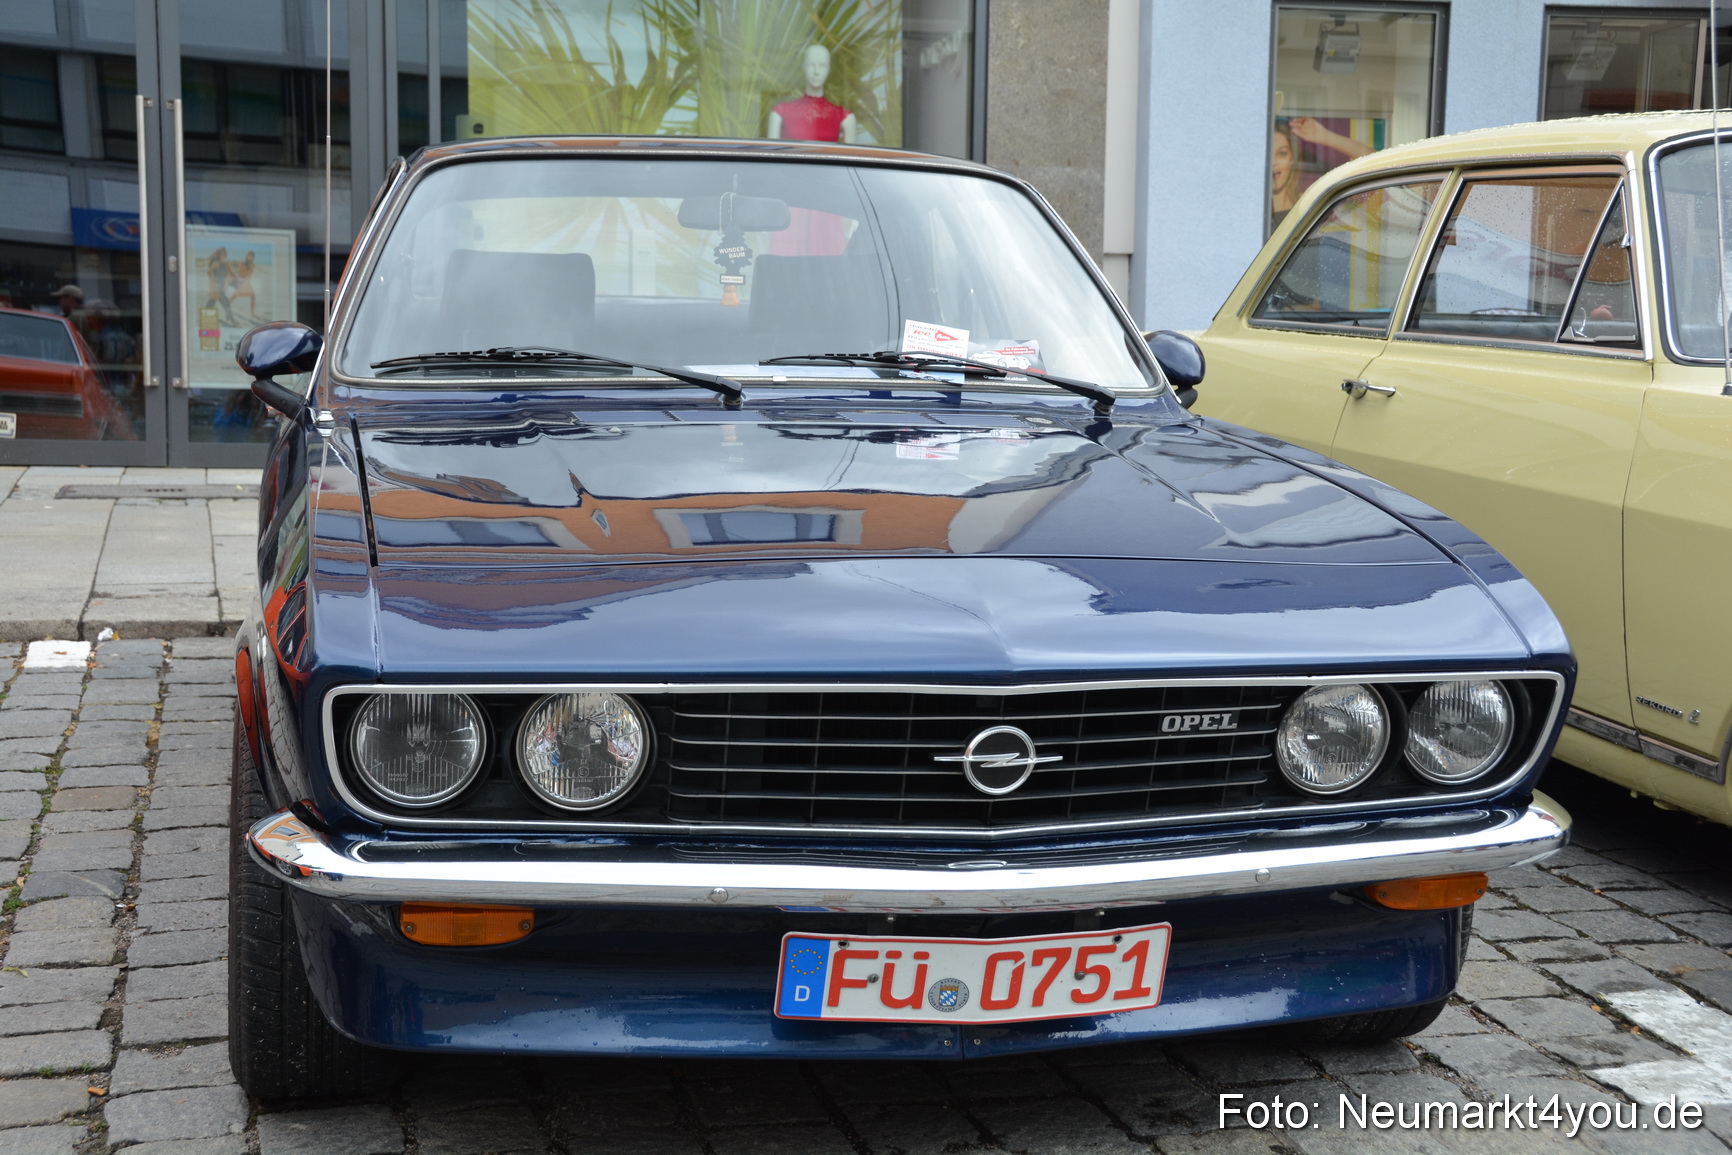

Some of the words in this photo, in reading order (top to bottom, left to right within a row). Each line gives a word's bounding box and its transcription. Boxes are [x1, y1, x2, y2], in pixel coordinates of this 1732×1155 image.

[719, 246, 747, 254] WUNDER-
[729, 251, 745, 259] BAUM
[1635, 695, 1683, 718] REKORD
[1161, 713, 1238, 734] OPEL
[795, 985, 810, 1002] D
[827, 949, 930, 1010] FÜ
[979, 939, 1152, 1011] 0751
